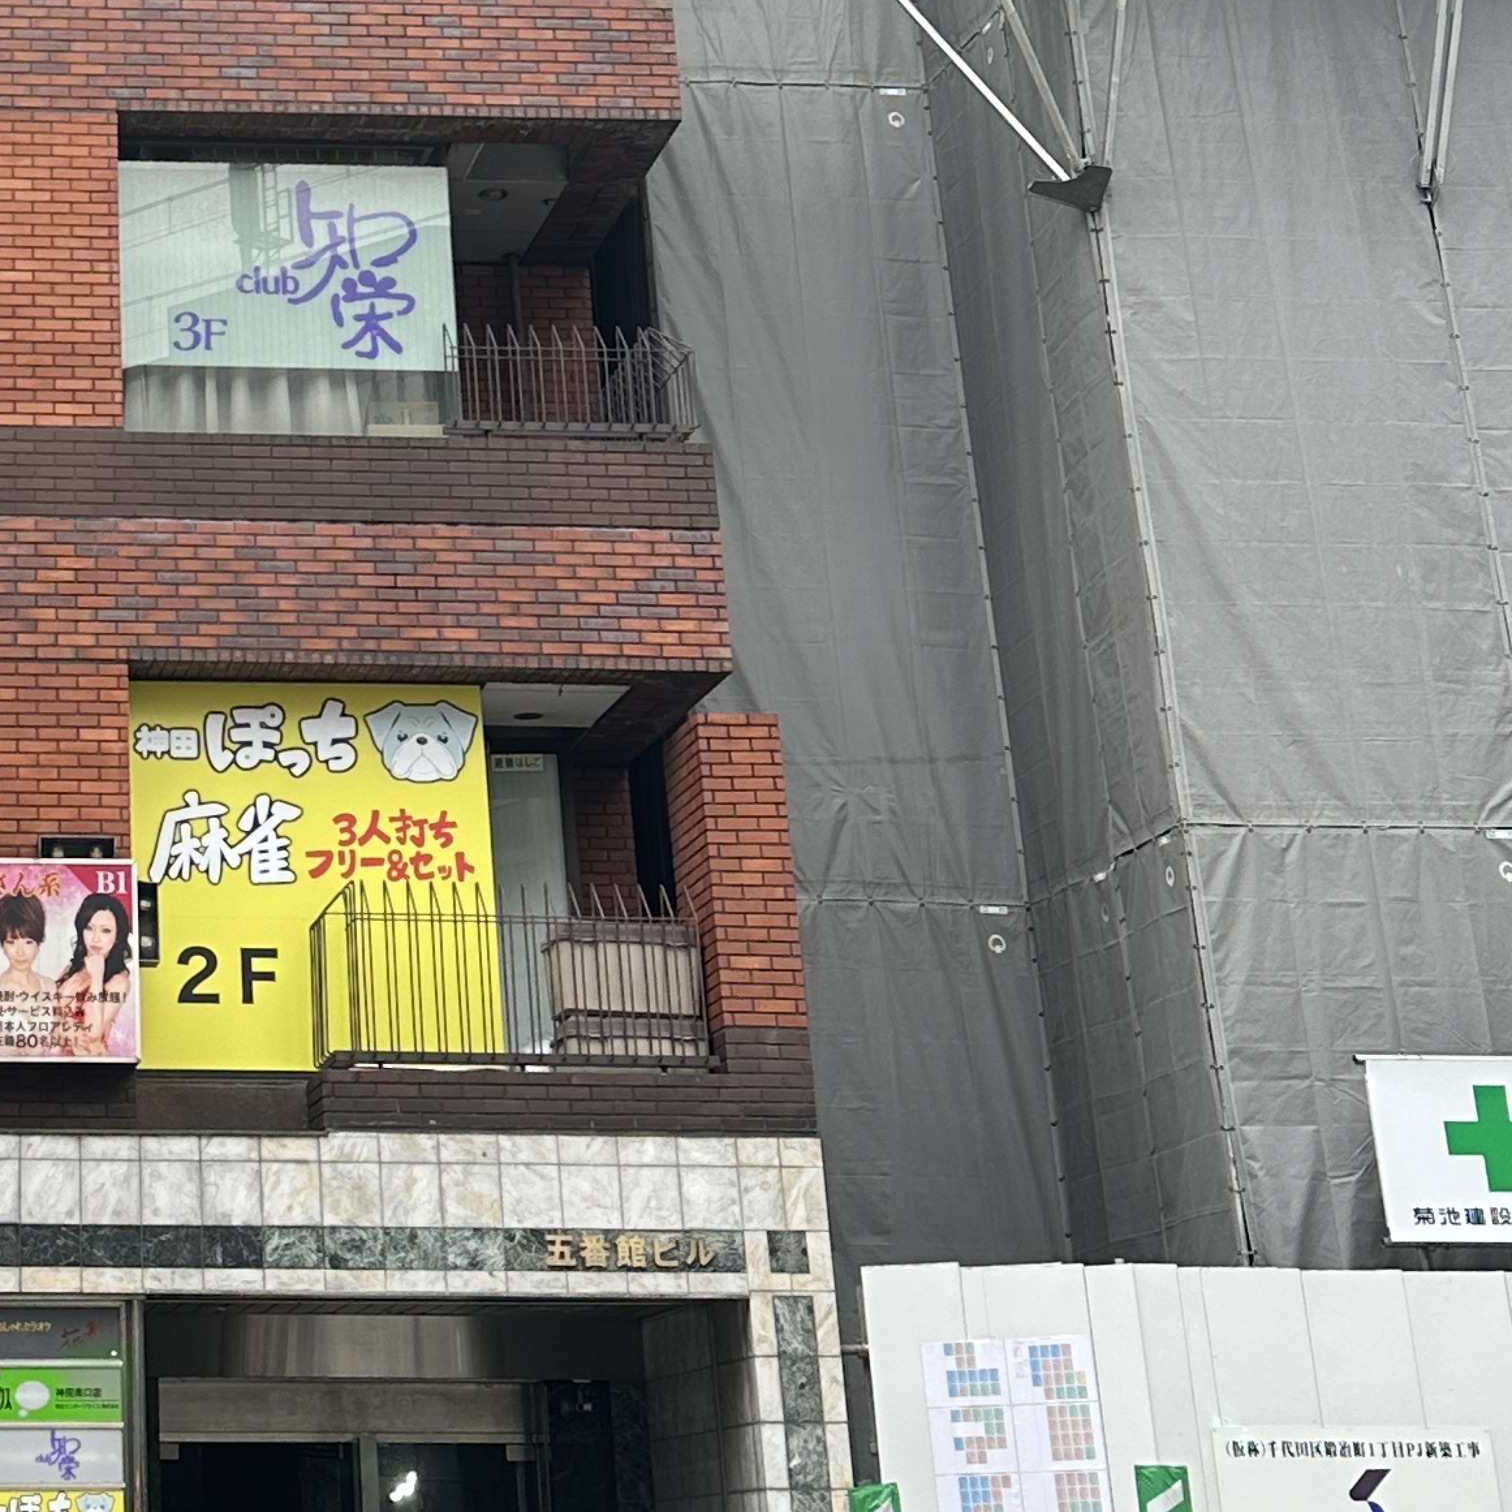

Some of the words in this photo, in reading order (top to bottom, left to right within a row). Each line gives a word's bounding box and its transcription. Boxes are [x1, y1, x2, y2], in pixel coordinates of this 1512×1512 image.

[236, 266, 300, 295] club
[172, 311, 228, 352] 3F
[149, 790, 303, 885] 麻雀
[332, 809, 458, 847] 3人打ち
[96, 870, 128, 895] B1
[305, 849, 476, 883] フリー&セット
[177, 947, 278, 1005] 2F
[544, 1232, 716, 1270] 五番館ビル
